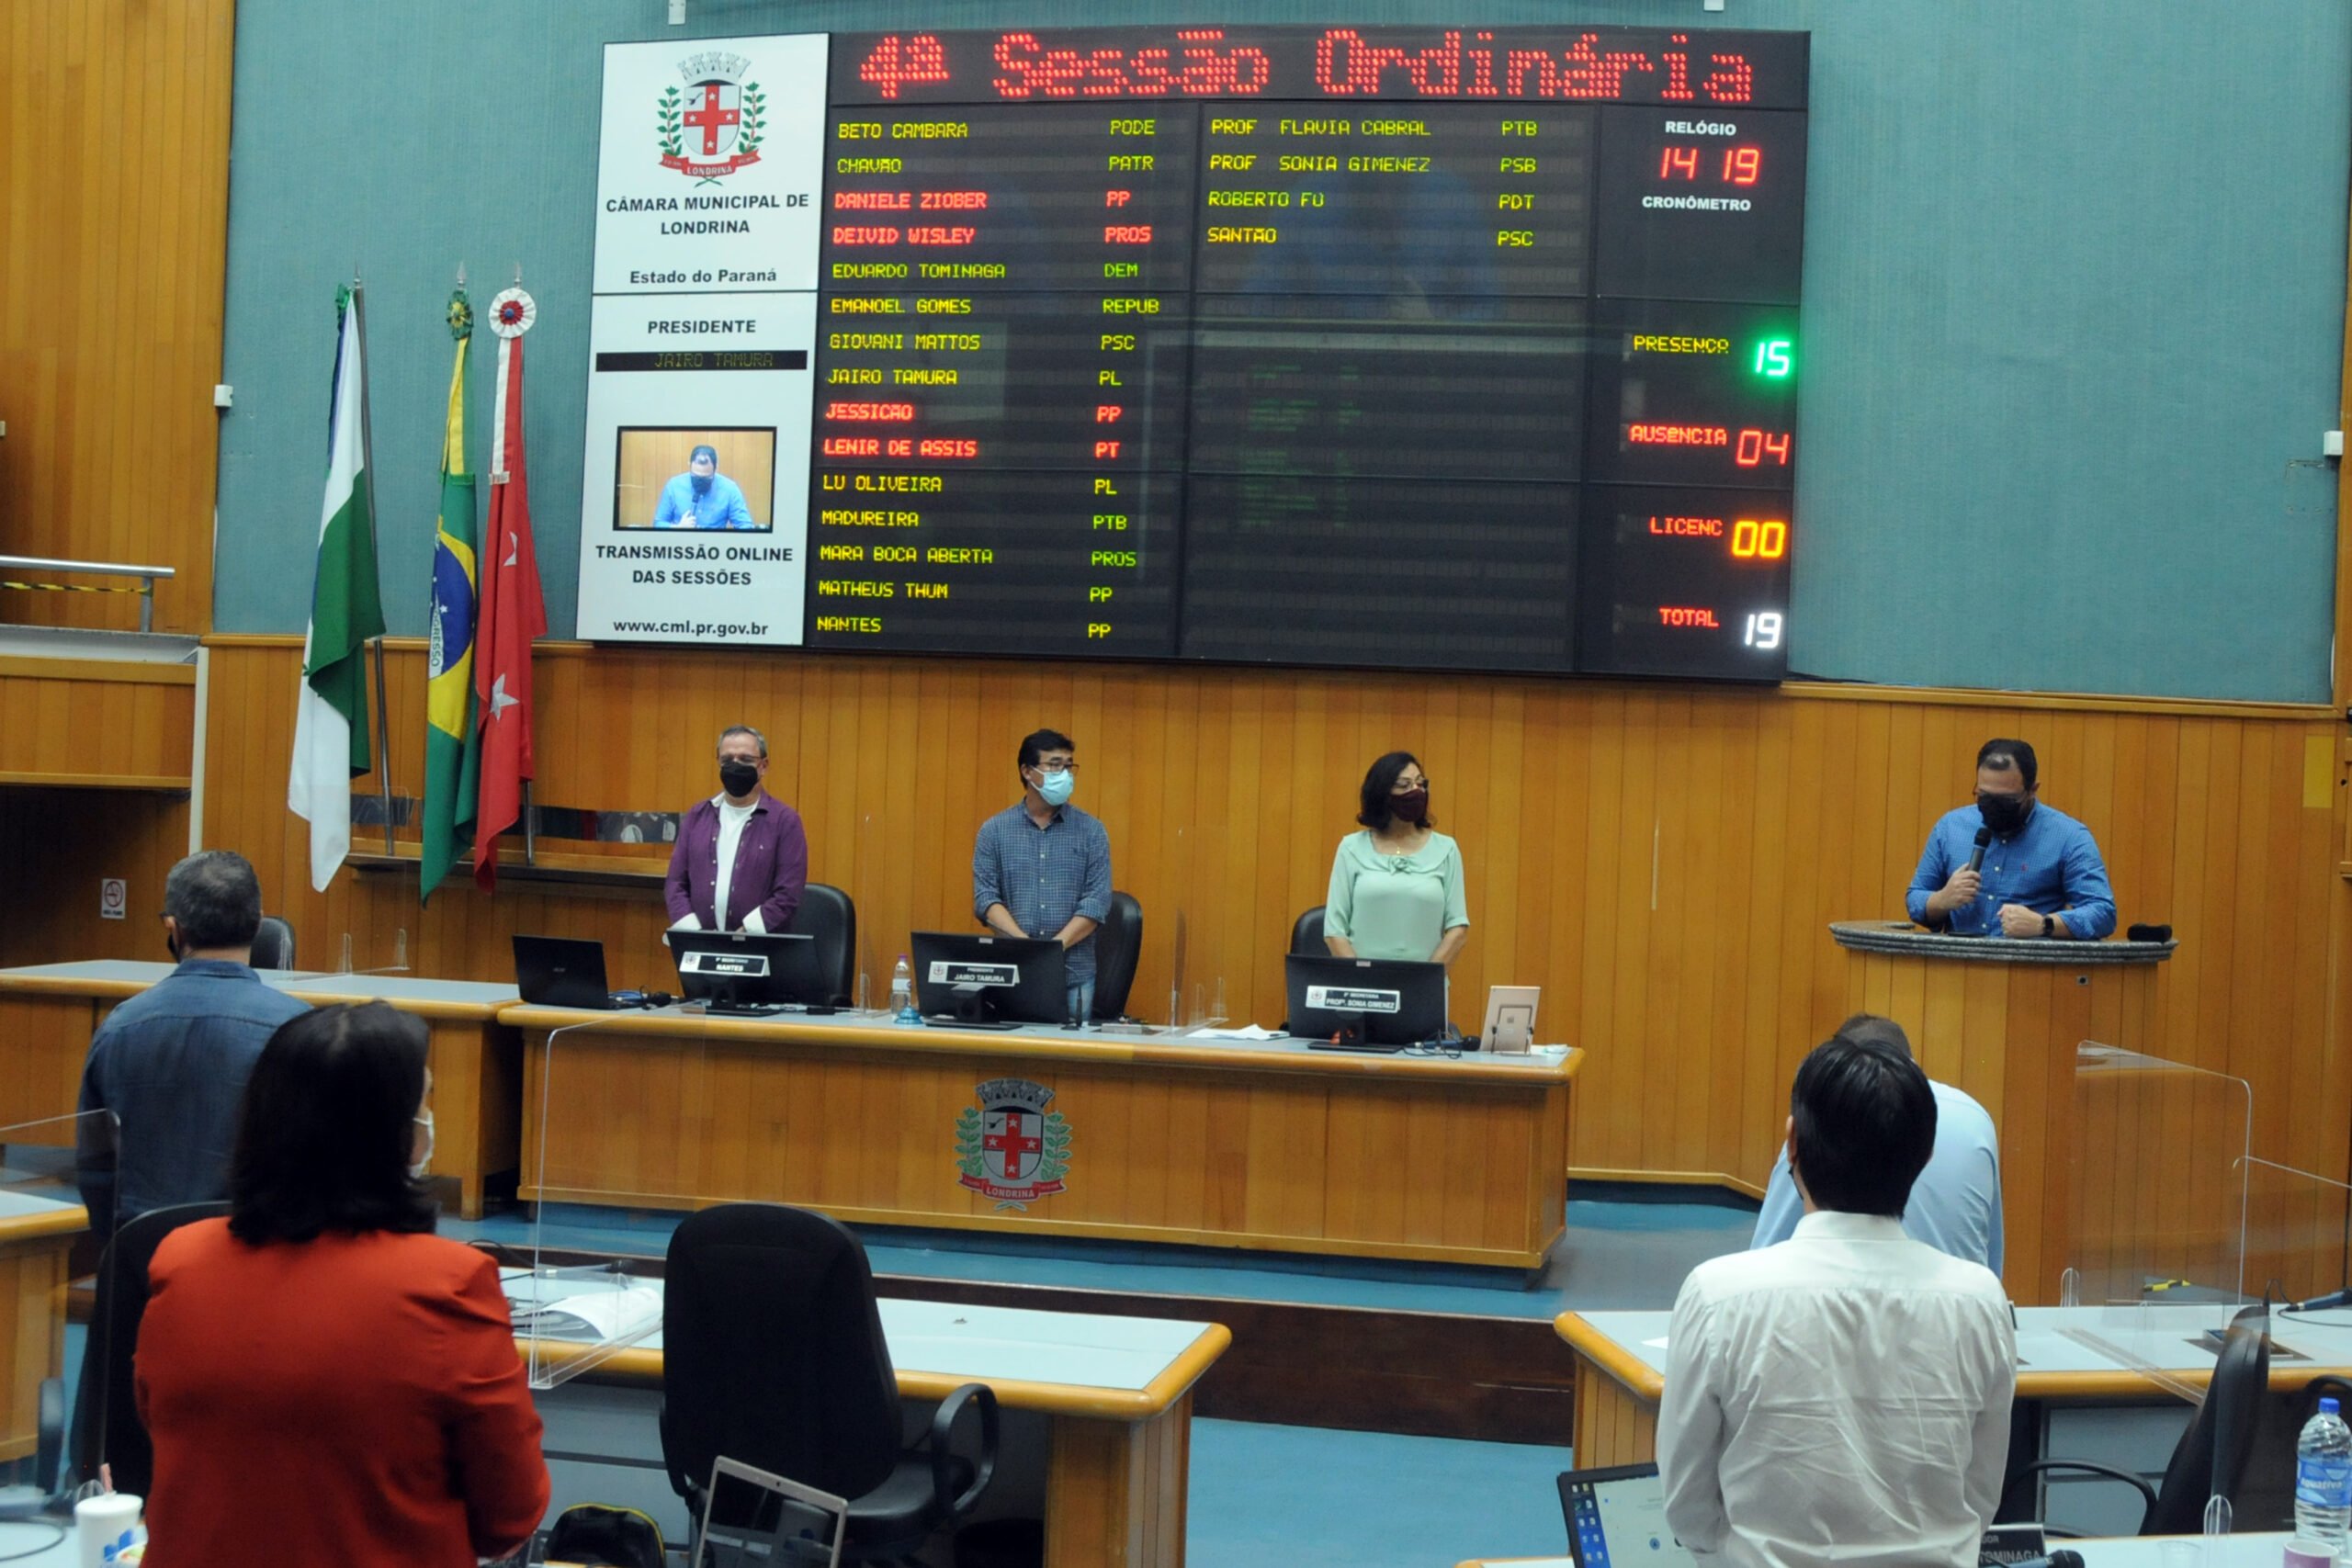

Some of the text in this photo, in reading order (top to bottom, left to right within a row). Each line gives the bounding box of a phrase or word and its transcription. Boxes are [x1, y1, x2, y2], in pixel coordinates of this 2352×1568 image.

[994, 29, 1270, 97] Sessão
[1315, 29, 1753, 101] Ordinária
[839, 124, 881, 138] BETO
[1111, 119, 1155, 134] PODE
[1212, 119, 1430, 135] PROF FLAVIA CABRAL
[1502, 121, 1537, 135] PTB
[1666, 120, 1736, 135] RELÓGIO
[687, 165, 733, 175] LONDRINA
[1109, 156, 1153, 170] PATR
[1211, 155, 1430, 172] PROF SONIA GIMENEZ
[1501, 158, 1535, 173] PSB
[1660, 147, 1760, 183] 14 19
[605, 195, 808, 212] CÂMARA MUNICIPAL DE
[835, 192, 987, 209] DANIELE ZIOBER
[1106, 191, 1130, 207] PP
[1209, 191, 1289, 207] ROBERTO
[1499, 195, 1534, 209] PDT
[1643, 196, 1750, 210] CRONÔMETRO
[662, 220, 750, 234] LONDRINA
[1105, 226, 1151, 243] PROS
[833, 227, 975, 244] DEIVID WISLEY
[1498, 231, 1532, 246] PSC
[630, 268, 776, 283] Estado do Paraná
[833, 264, 1005, 277] EDUARDO TOMINAGA
[1104, 264, 1137, 276] DEM
[831, 299, 970, 313] EMANOEL GOMES
[1103, 299, 1159, 313] REPUB
[649, 321, 755, 333] PRESIDENTE
[831, 334, 980, 350] GIOVANI MATTOS
[1102, 335, 1135, 350] PSC
[654, 353, 773, 367] JAIRO TAMURA
[1755, 340, 1791, 376] 15
[828, 369, 956, 384] JAIRO TAMURA
[1100, 371, 1121, 385] PL
[1097, 406, 1122, 423] PP
[823, 438, 978, 457] LENIR DE ASSIS
[1095, 442, 1120, 457] PT
[1736, 430, 1789, 466] 04
[823, 475, 941, 491] LU OLIVEIRA
[1095, 479, 1116, 494] PL
[822, 511, 919, 526] MADUREIRA
[1093, 515, 1126, 529] PTB
[1733, 521, 1786, 558] 00
[595, 545, 792, 561] TRANSMISSÃO ONLINE
[820, 546, 992, 563] MARA BOCA ABERTA
[1091, 551, 1136, 566] PROS
[633, 570, 751, 585] DAS SESSÕES
[819, 581, 947, 598] MATHEUS THUM
[1090, 588, 1112, 602] PP
[818, 617, 881, 632] NANTES
[1659, 607, 1719, 627] TOTAL
[613, 620, 768, 637] www.cml.pr.gov.br
[1089, 624, 1111, 637] PP
[1745, 613, 1781, 649] 19
[986, 1187, 1035, 1198] LONDRINA
